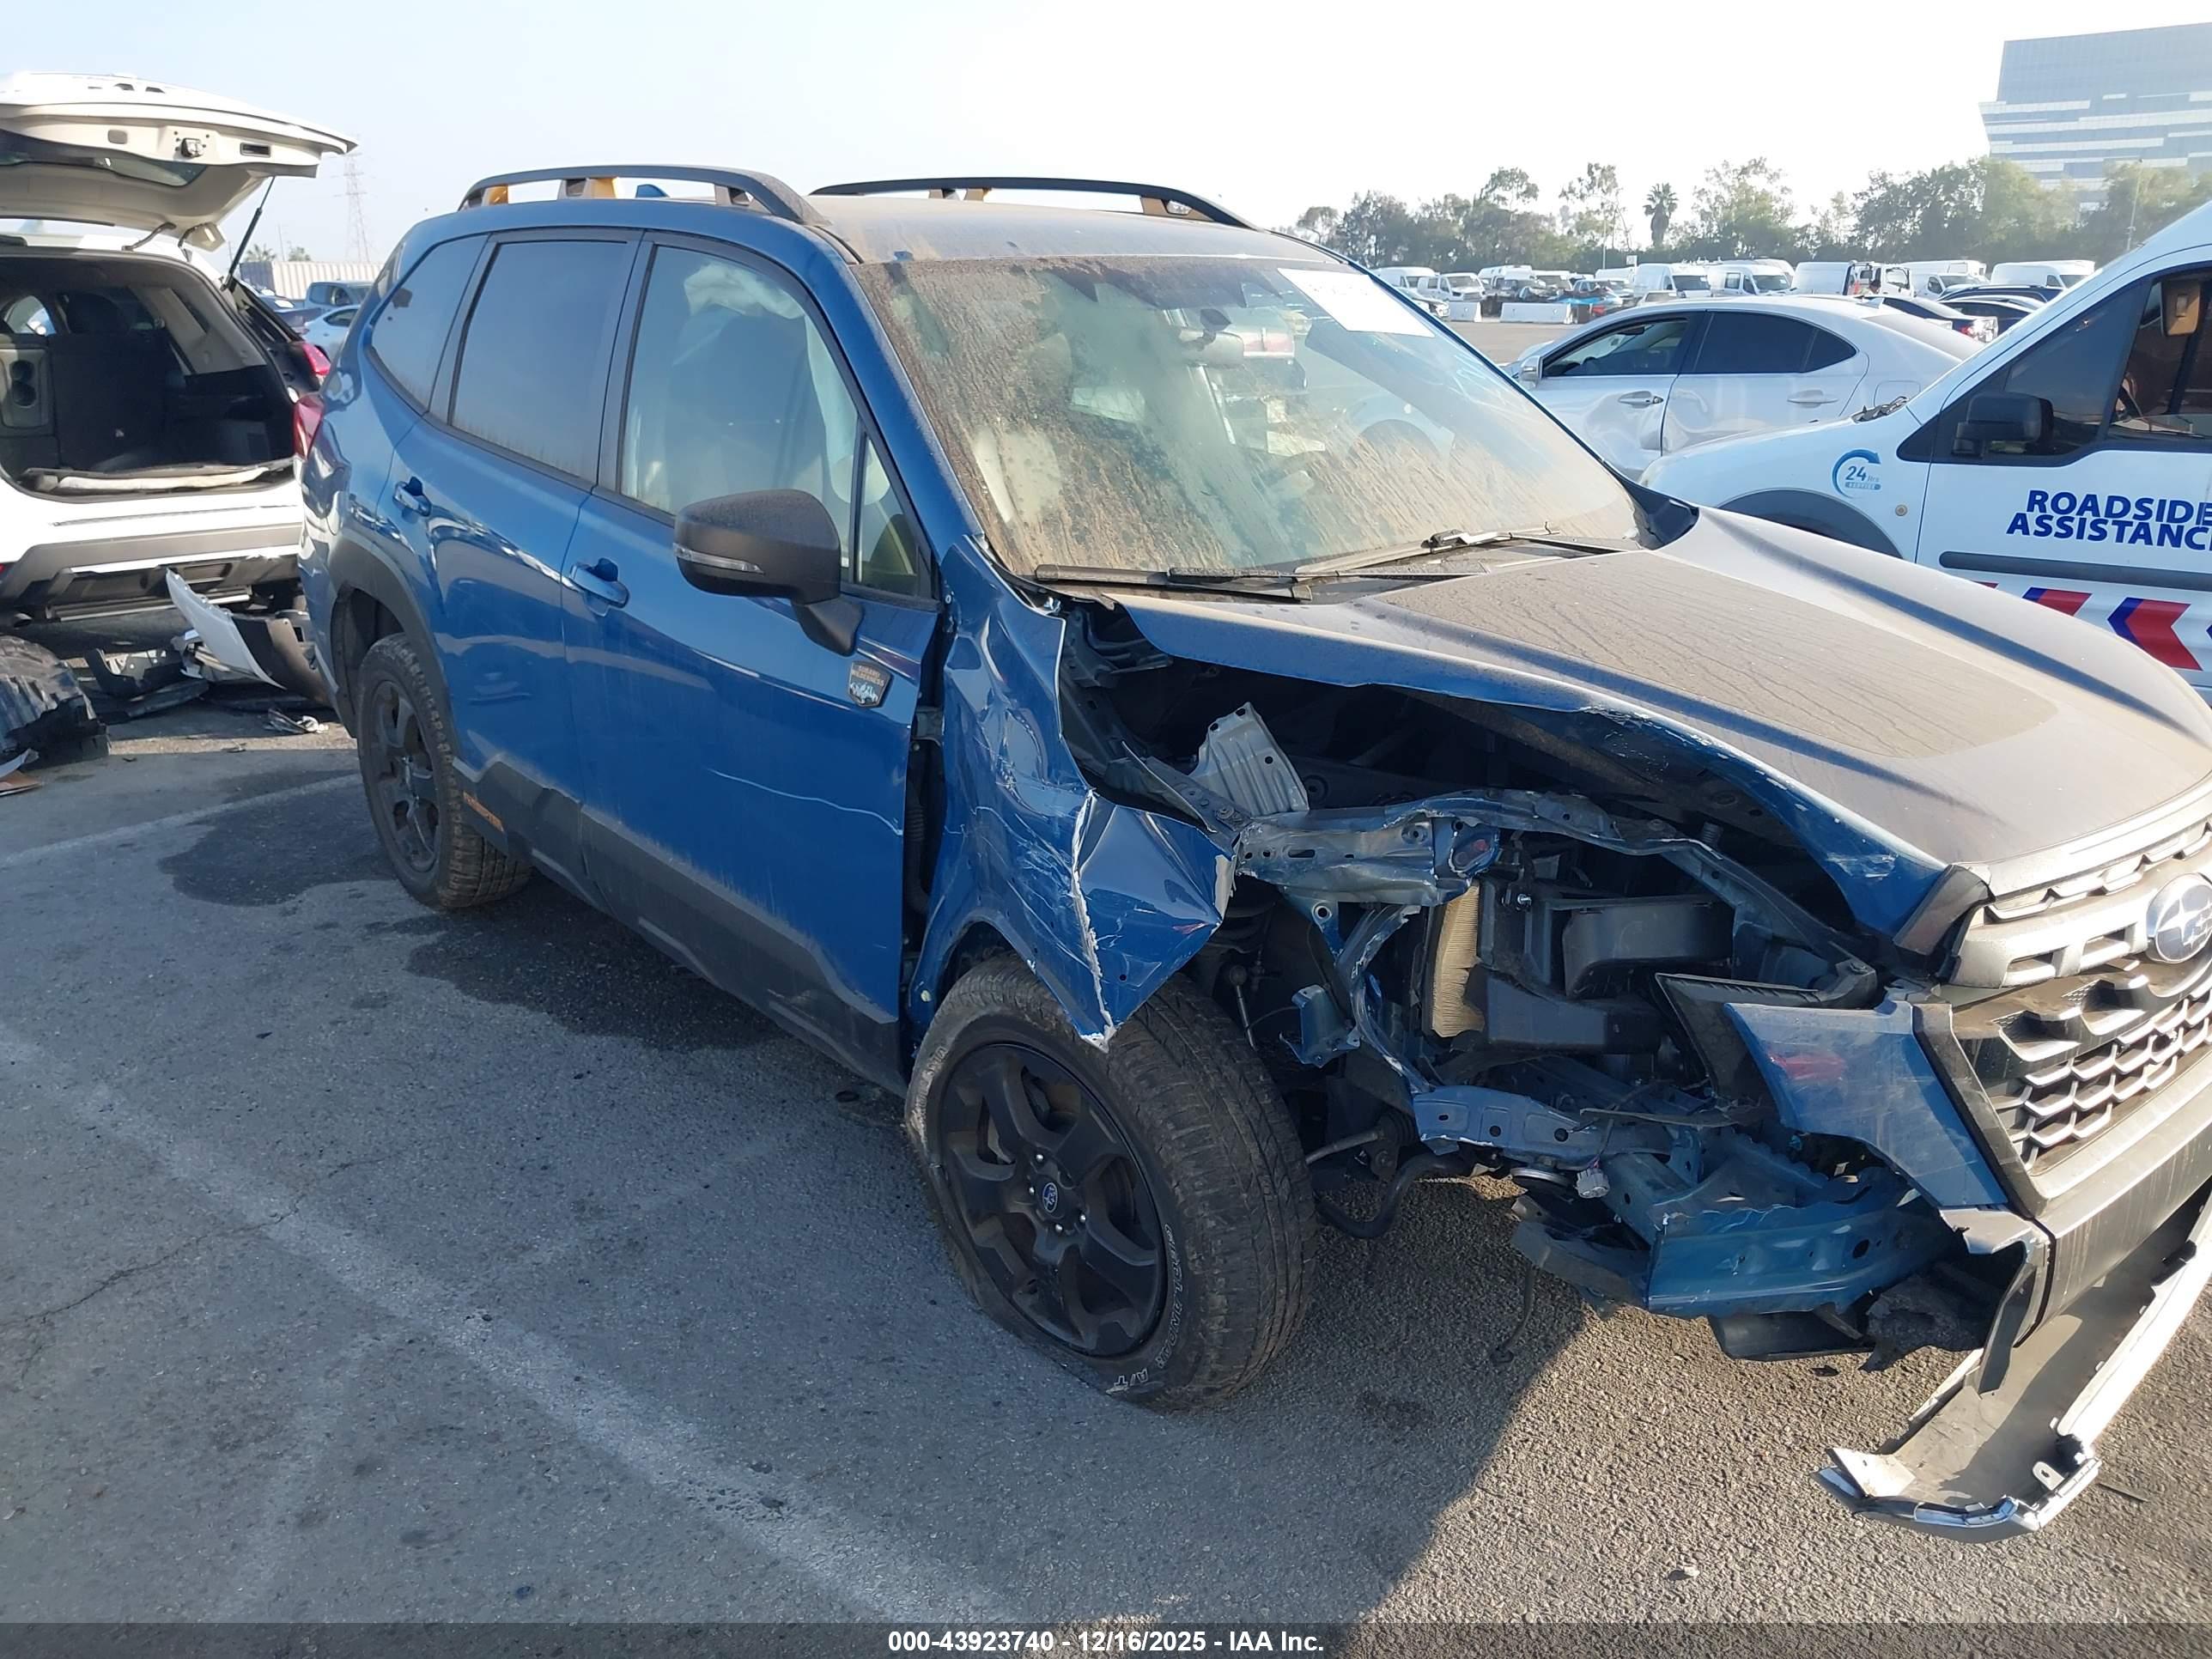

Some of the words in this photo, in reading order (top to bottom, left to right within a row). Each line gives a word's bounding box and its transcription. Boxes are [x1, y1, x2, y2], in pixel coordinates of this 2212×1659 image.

[1845, 465, 1867, 482] 24
[2027, 489, 2212, 526] ROADSIDE
[2006, 513, 2212, 551] ASSISTANC
